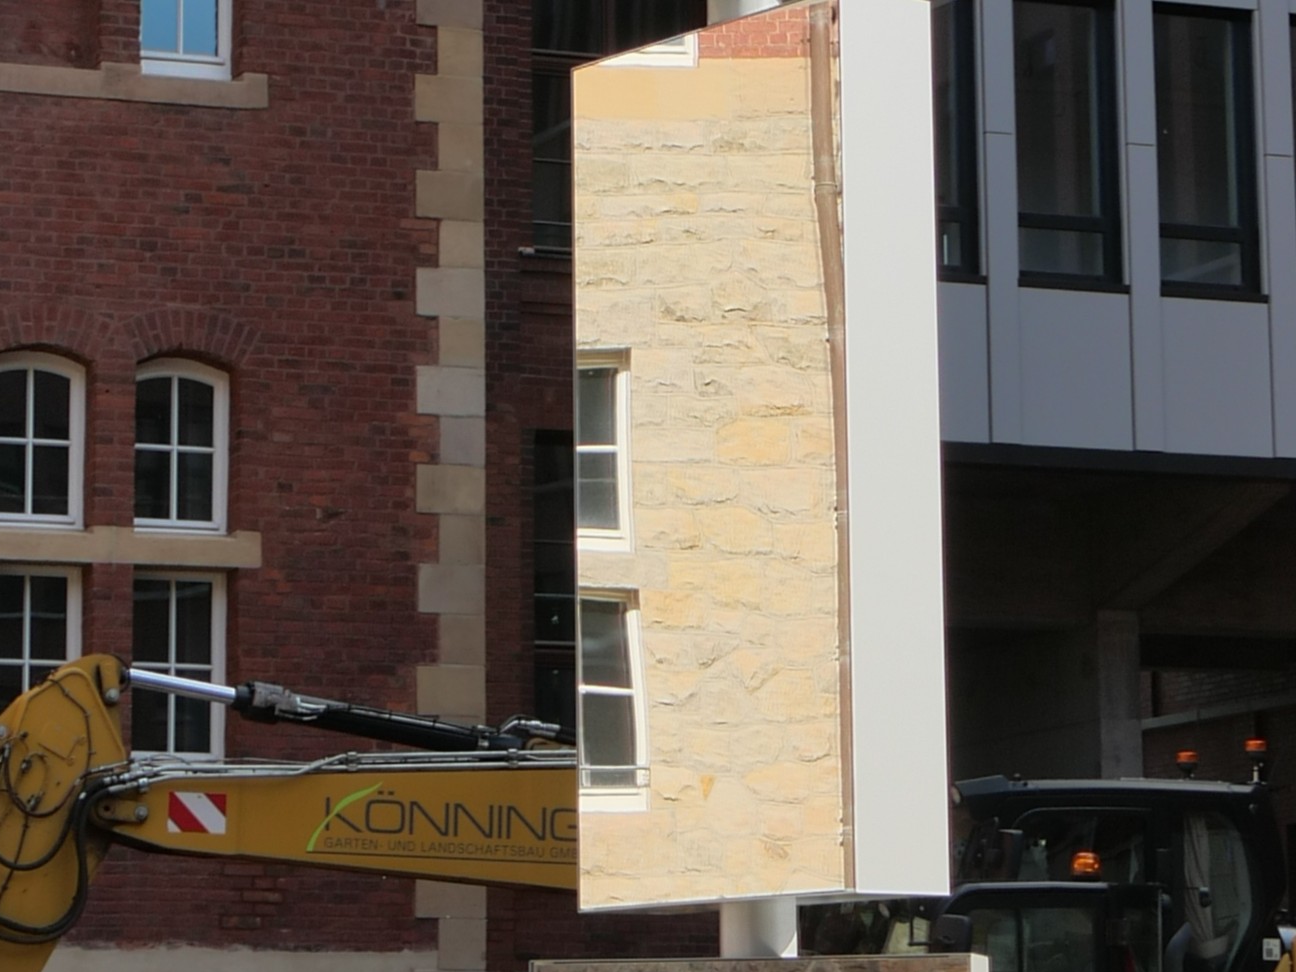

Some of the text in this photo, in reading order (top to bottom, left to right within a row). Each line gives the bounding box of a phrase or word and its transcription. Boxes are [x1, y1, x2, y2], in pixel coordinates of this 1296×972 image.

[324, 790, 577, 842] KÖNNING
[324, 836, 577, 859] GARTEN- UND LANDSCHAFTSBAU GMB
